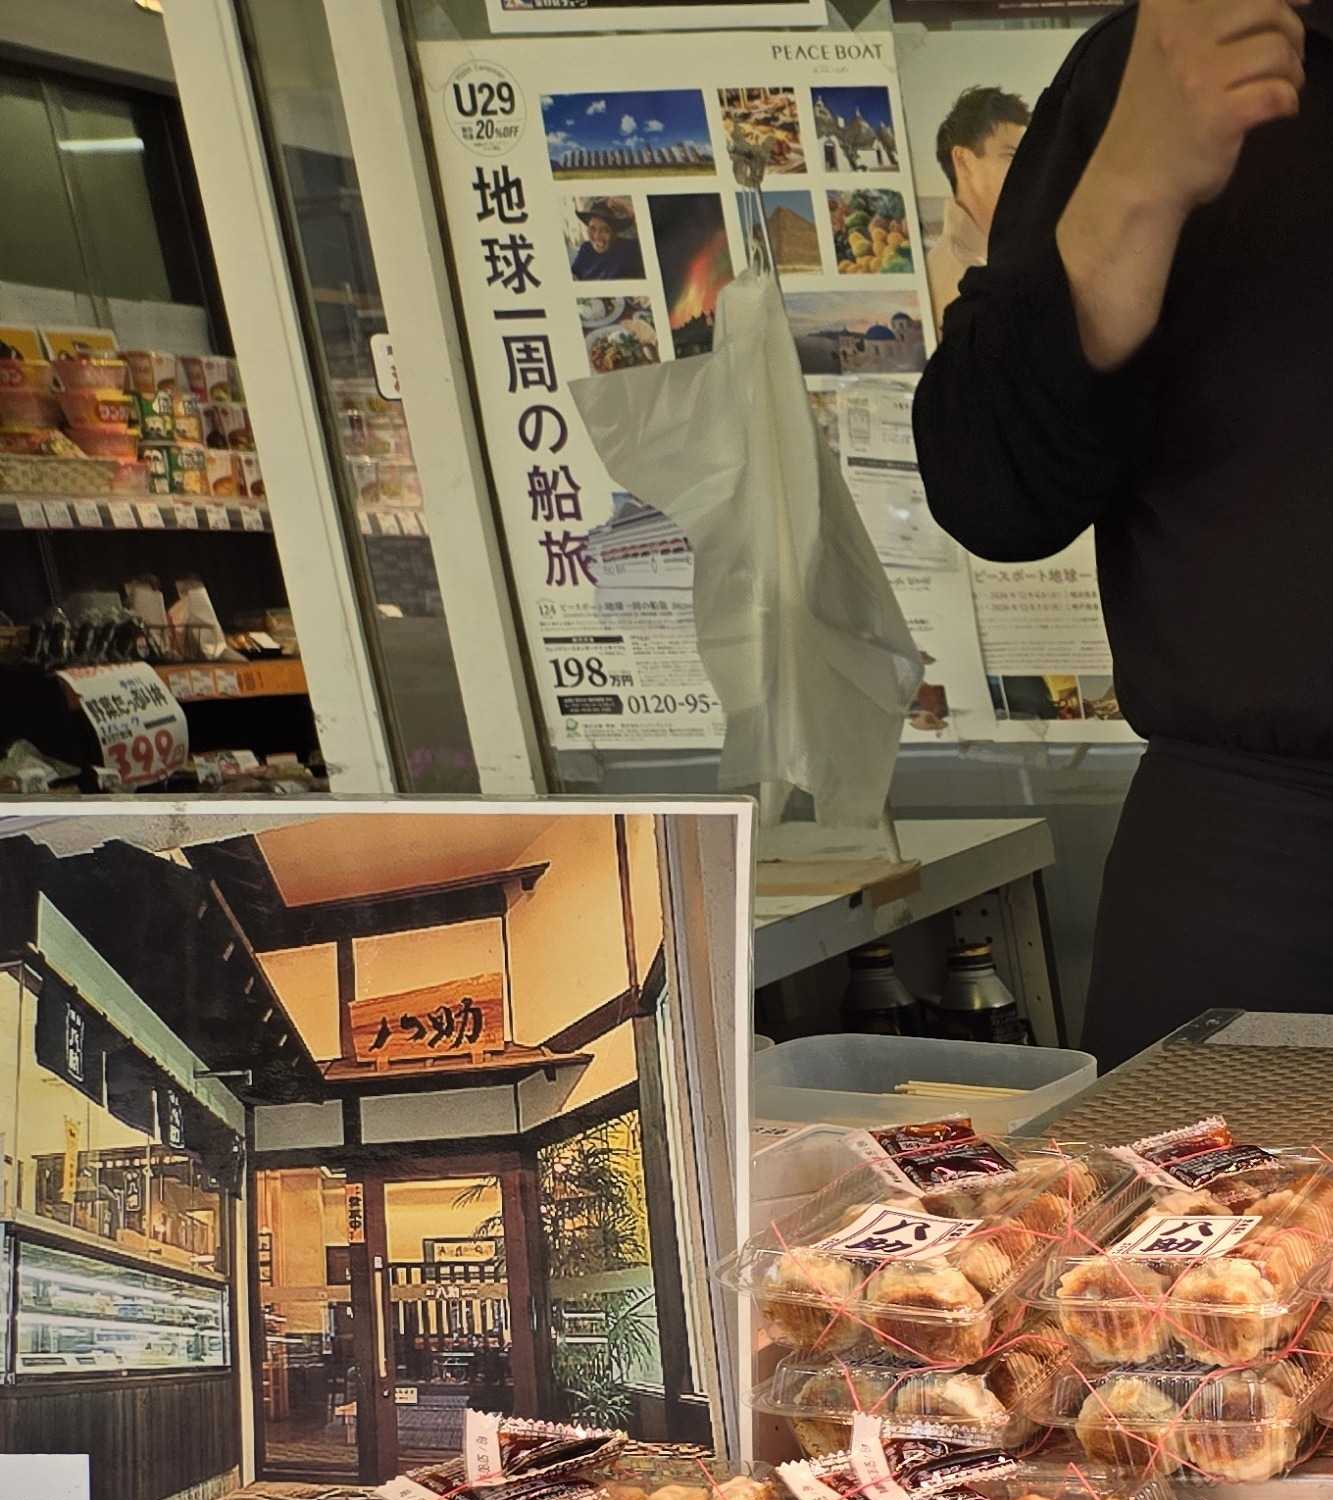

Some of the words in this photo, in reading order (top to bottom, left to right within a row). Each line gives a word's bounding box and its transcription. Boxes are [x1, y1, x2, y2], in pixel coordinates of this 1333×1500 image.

[772, 44, 830, 60] PEACE
[835, 44, 882, 60] BOAT
[452, 80, 515, 117] U29
[472, 165, 598, 587] 地球一周の船旅
[845, 1219, 931, 1253] 八助
[1140, 1221, 1214, 1253] 八助
